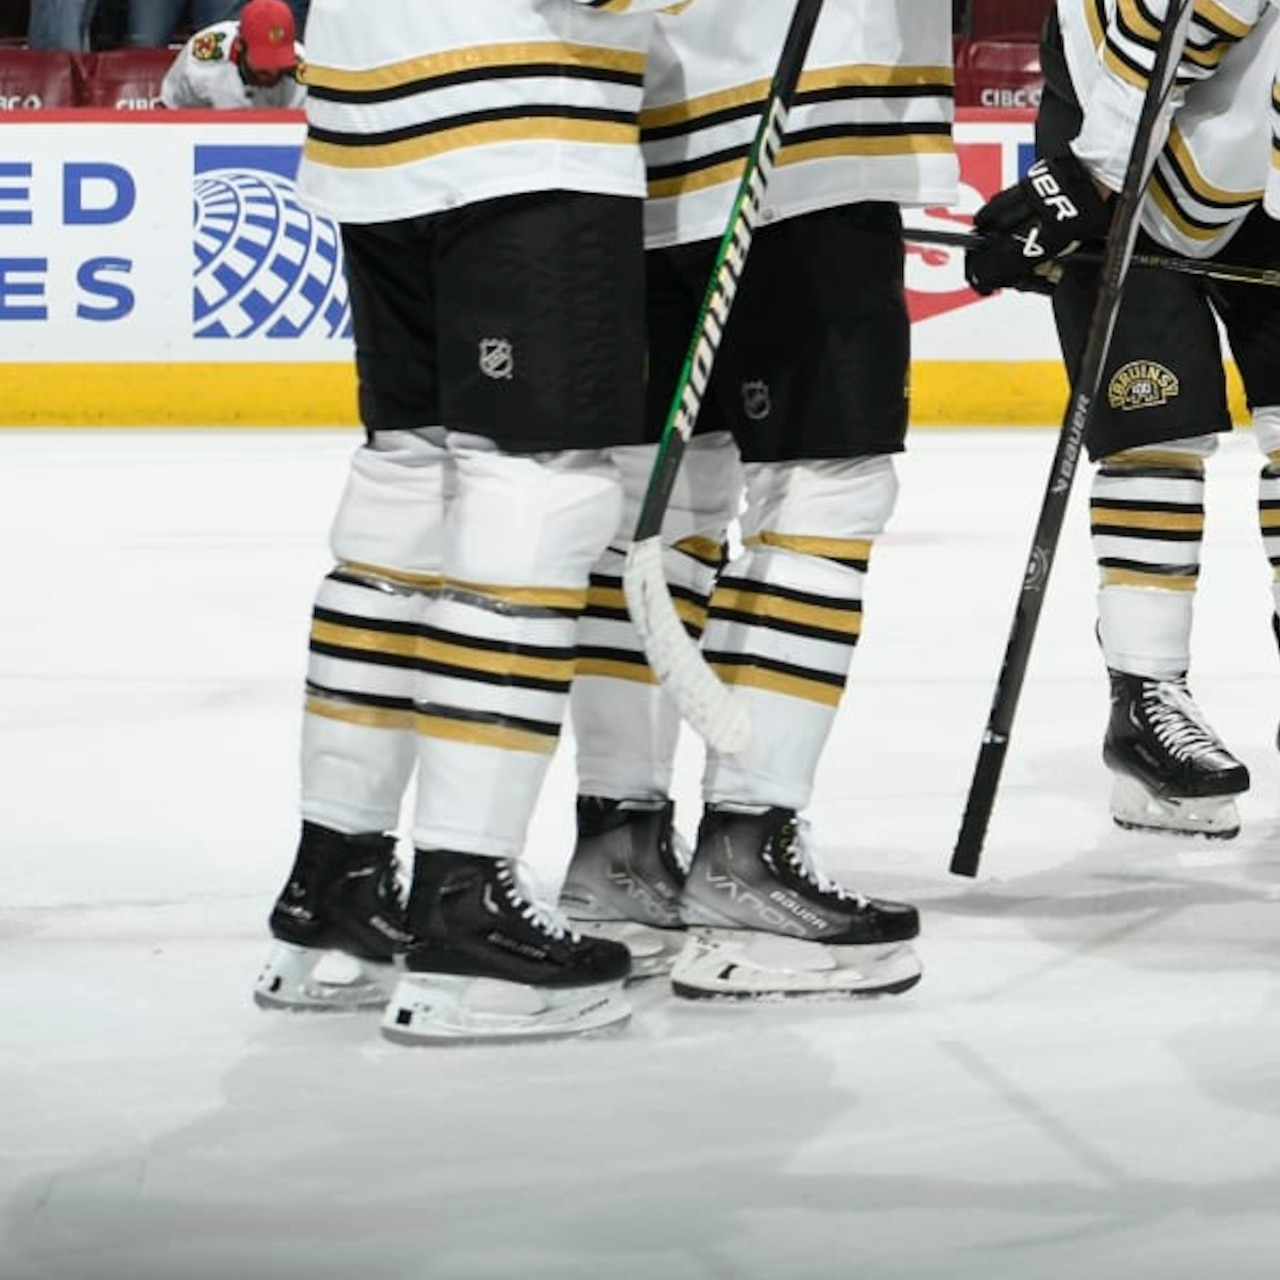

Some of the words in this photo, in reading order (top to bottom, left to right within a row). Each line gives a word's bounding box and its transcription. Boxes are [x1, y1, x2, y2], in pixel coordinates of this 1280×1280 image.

[981, 89, 1026, 107] CIBC
[672, 97, 790, 444] WARRIOR
[768, 890, 828, 931] BAUER
